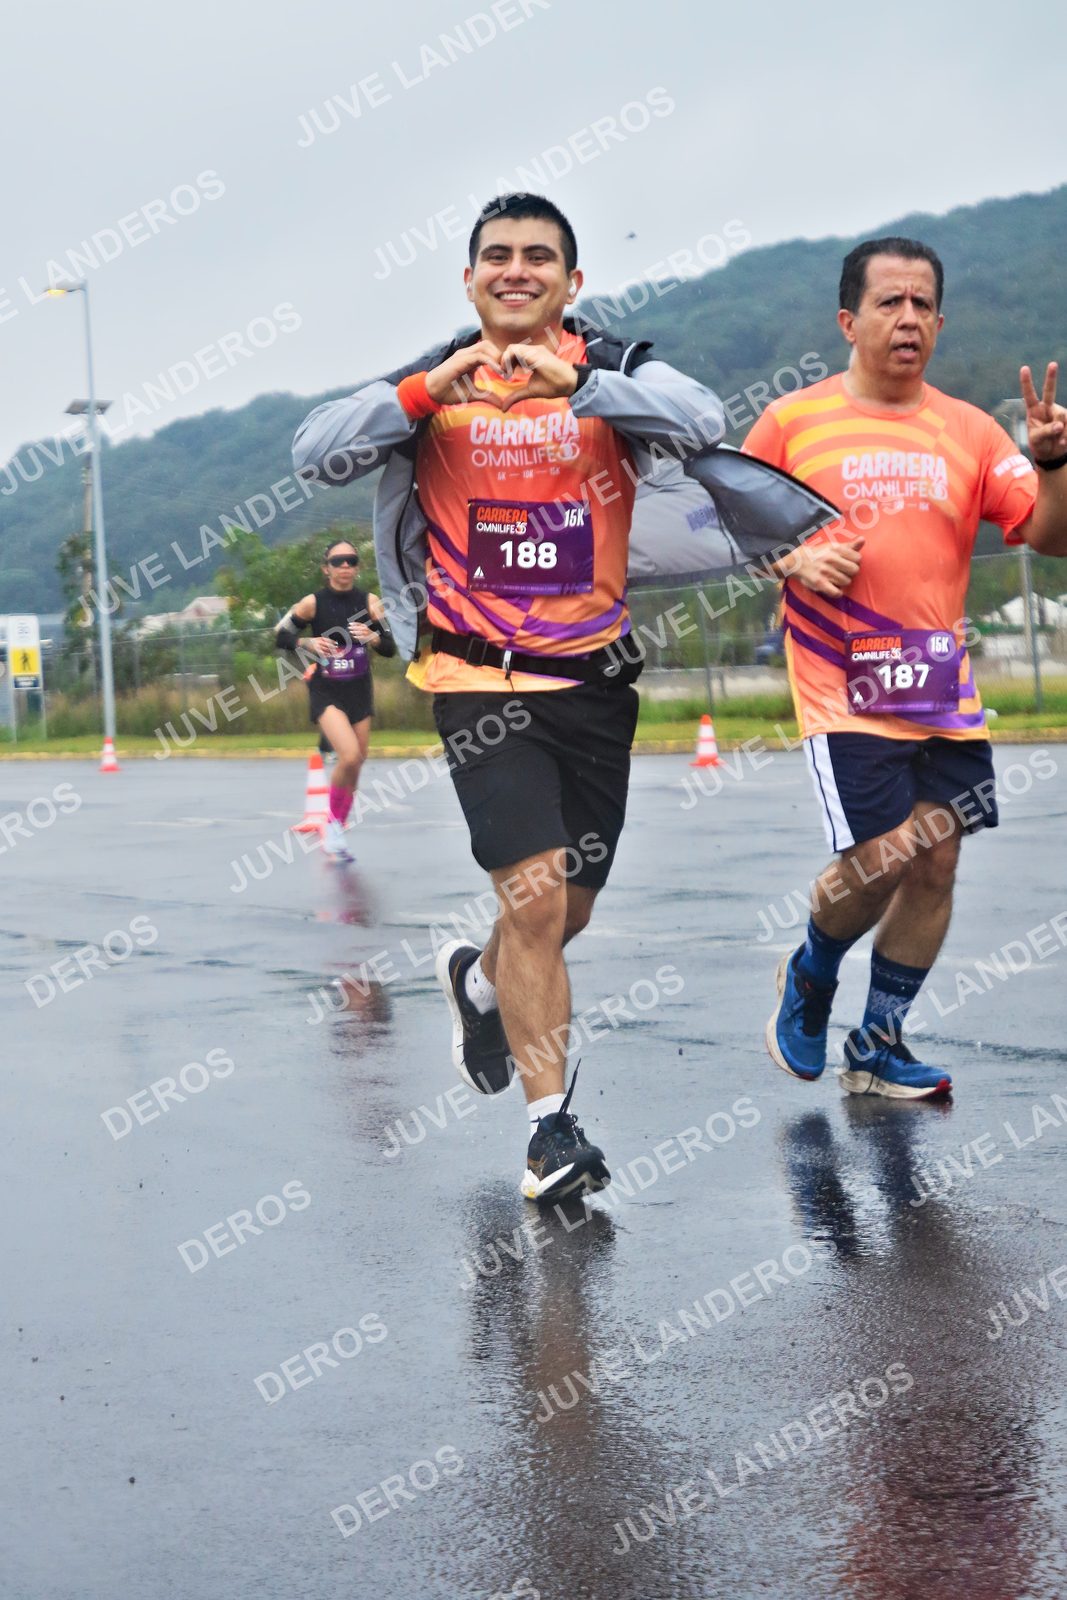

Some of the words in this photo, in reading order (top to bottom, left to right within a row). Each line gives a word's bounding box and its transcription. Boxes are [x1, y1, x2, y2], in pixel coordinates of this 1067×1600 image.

[470, 409, 579, 446] CARRERA
[471, 445, 556, 467] OMNILIFE
[842, 451, 947, 481] CARRERA
[843, 480, 929, 500] OMNILIFE
[477, 506, 528, 523] CARRERA
[476, 521, 515, 534] OMNILIFE
[500, 540, 558, 569] 188
[852, 636, 902, 652] CARRERA
[333, 659, 355, 670] 591
[851, 651, 890, 662] OMNILIFE
[878, 664, 930, 689] 187
